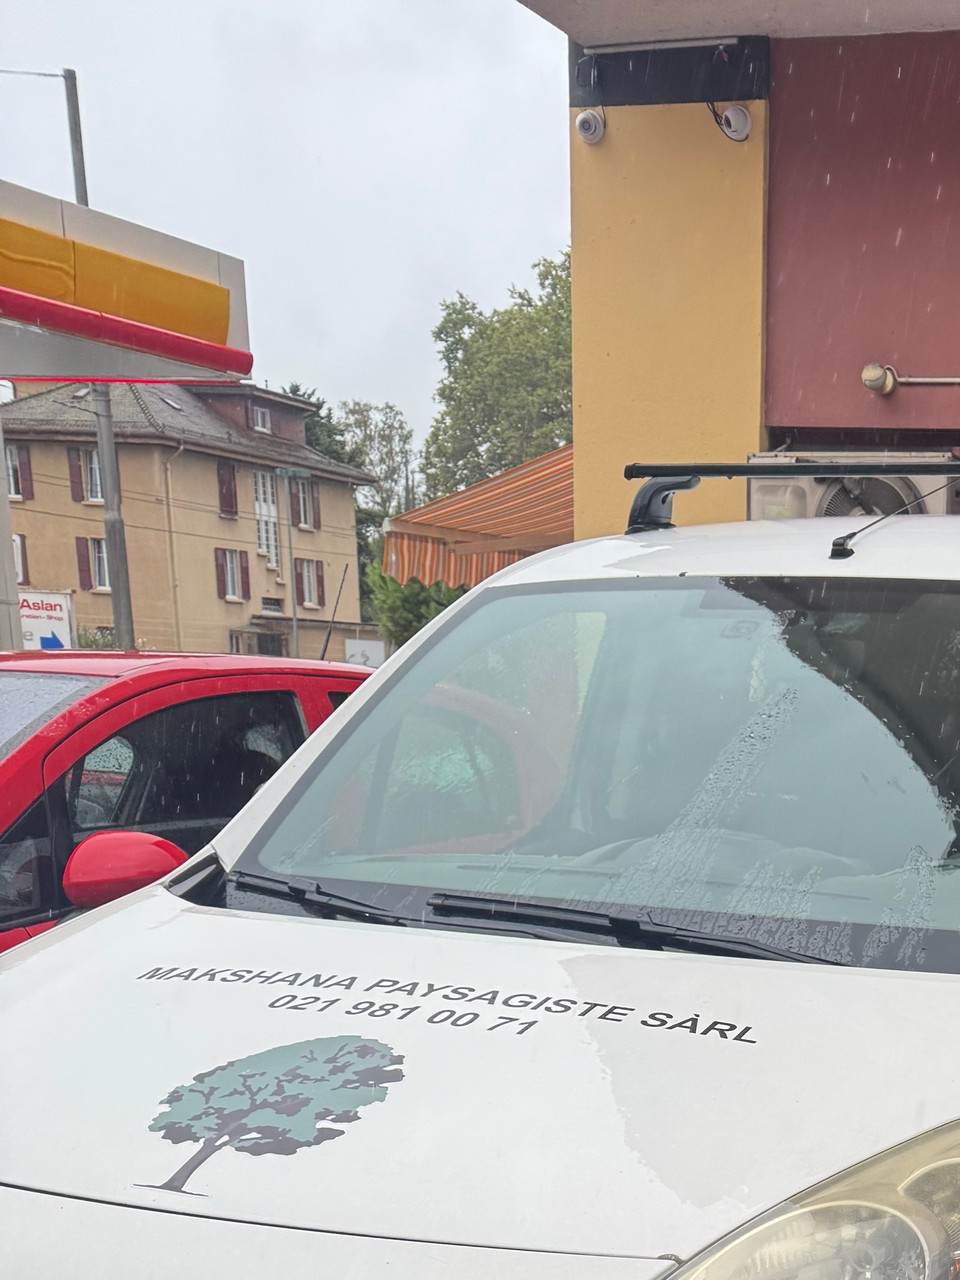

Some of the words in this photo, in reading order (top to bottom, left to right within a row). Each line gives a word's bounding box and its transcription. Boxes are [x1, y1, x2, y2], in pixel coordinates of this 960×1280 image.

[135, 966, 359, 991] MAKSHANA
[363, 978, 636, 1023] PAYSAGISTE
[268, 994, 342, 1013] 021
[344, 1000, 422, 1021] 981
[427, 1009, 480, 1028] 00
[486, 1015, 540, 1036] 71
